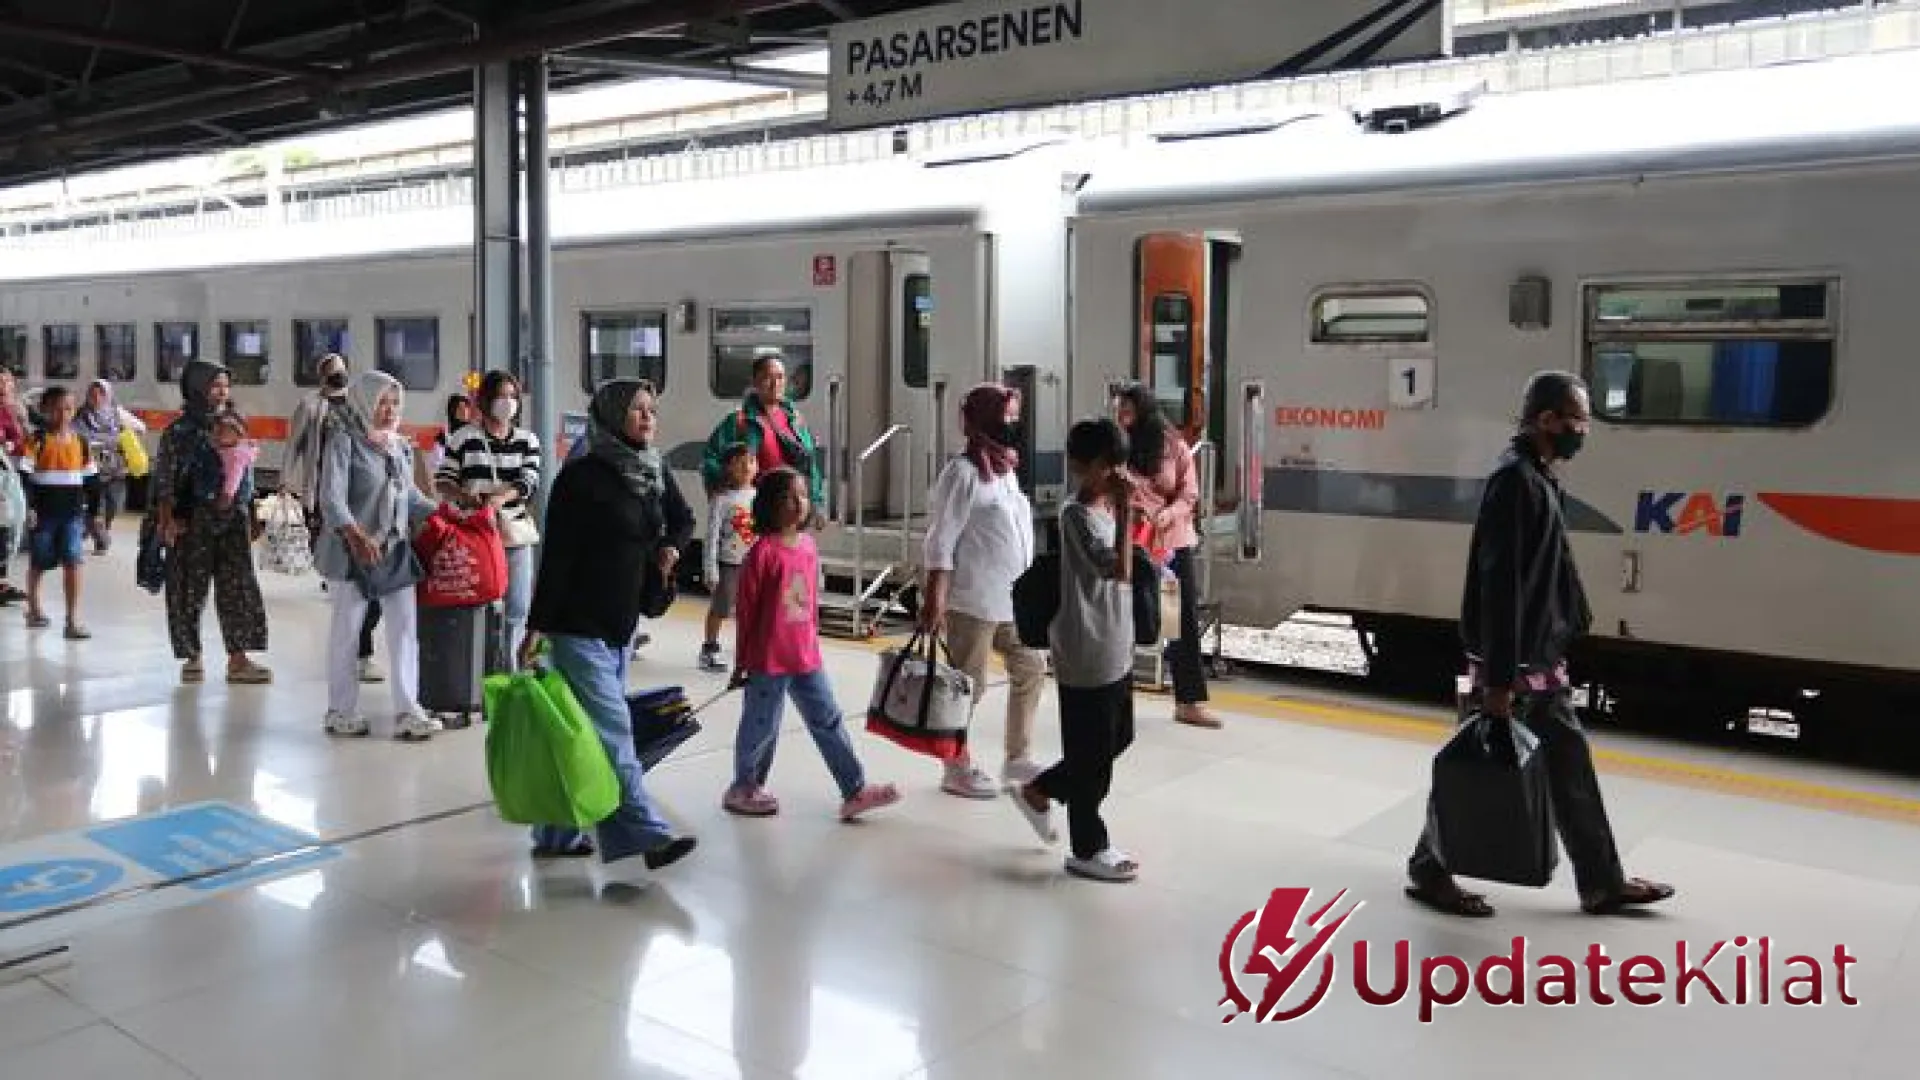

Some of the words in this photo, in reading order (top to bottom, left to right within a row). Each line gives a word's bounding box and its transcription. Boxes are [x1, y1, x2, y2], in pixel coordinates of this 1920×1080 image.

[847, 0, 1082, 75] PASARSENEN
[900, 72, 922, 100] M
[1401, 367, 1416, 397] 1
[1275, 406, 1386, 431] EKONOMI
[1635, 491, 1745, 537] KAI
